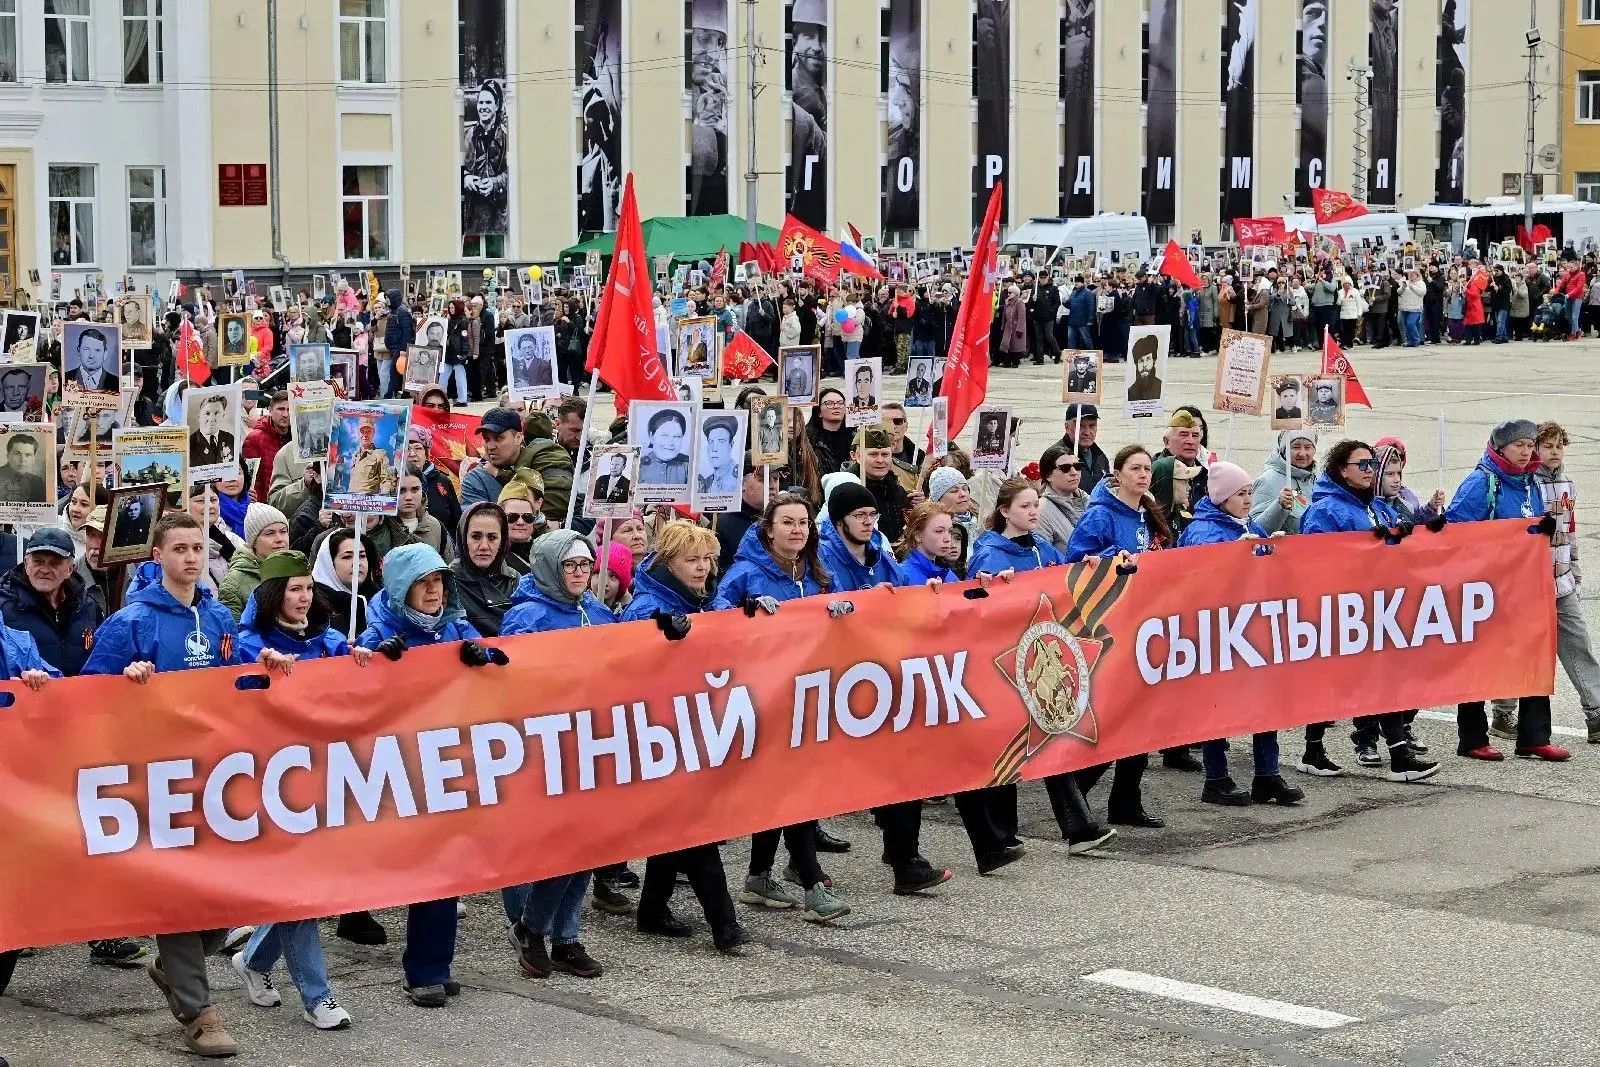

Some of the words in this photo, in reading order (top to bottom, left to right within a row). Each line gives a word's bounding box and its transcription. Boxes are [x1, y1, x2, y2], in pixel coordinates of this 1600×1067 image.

[1136, 582, 1494, 684] СЫКТЫВКАР
[77, 670, 756, 855] БЕССМЕРТНЫЙ
[791, 651, 986, 747] ПОЛК
